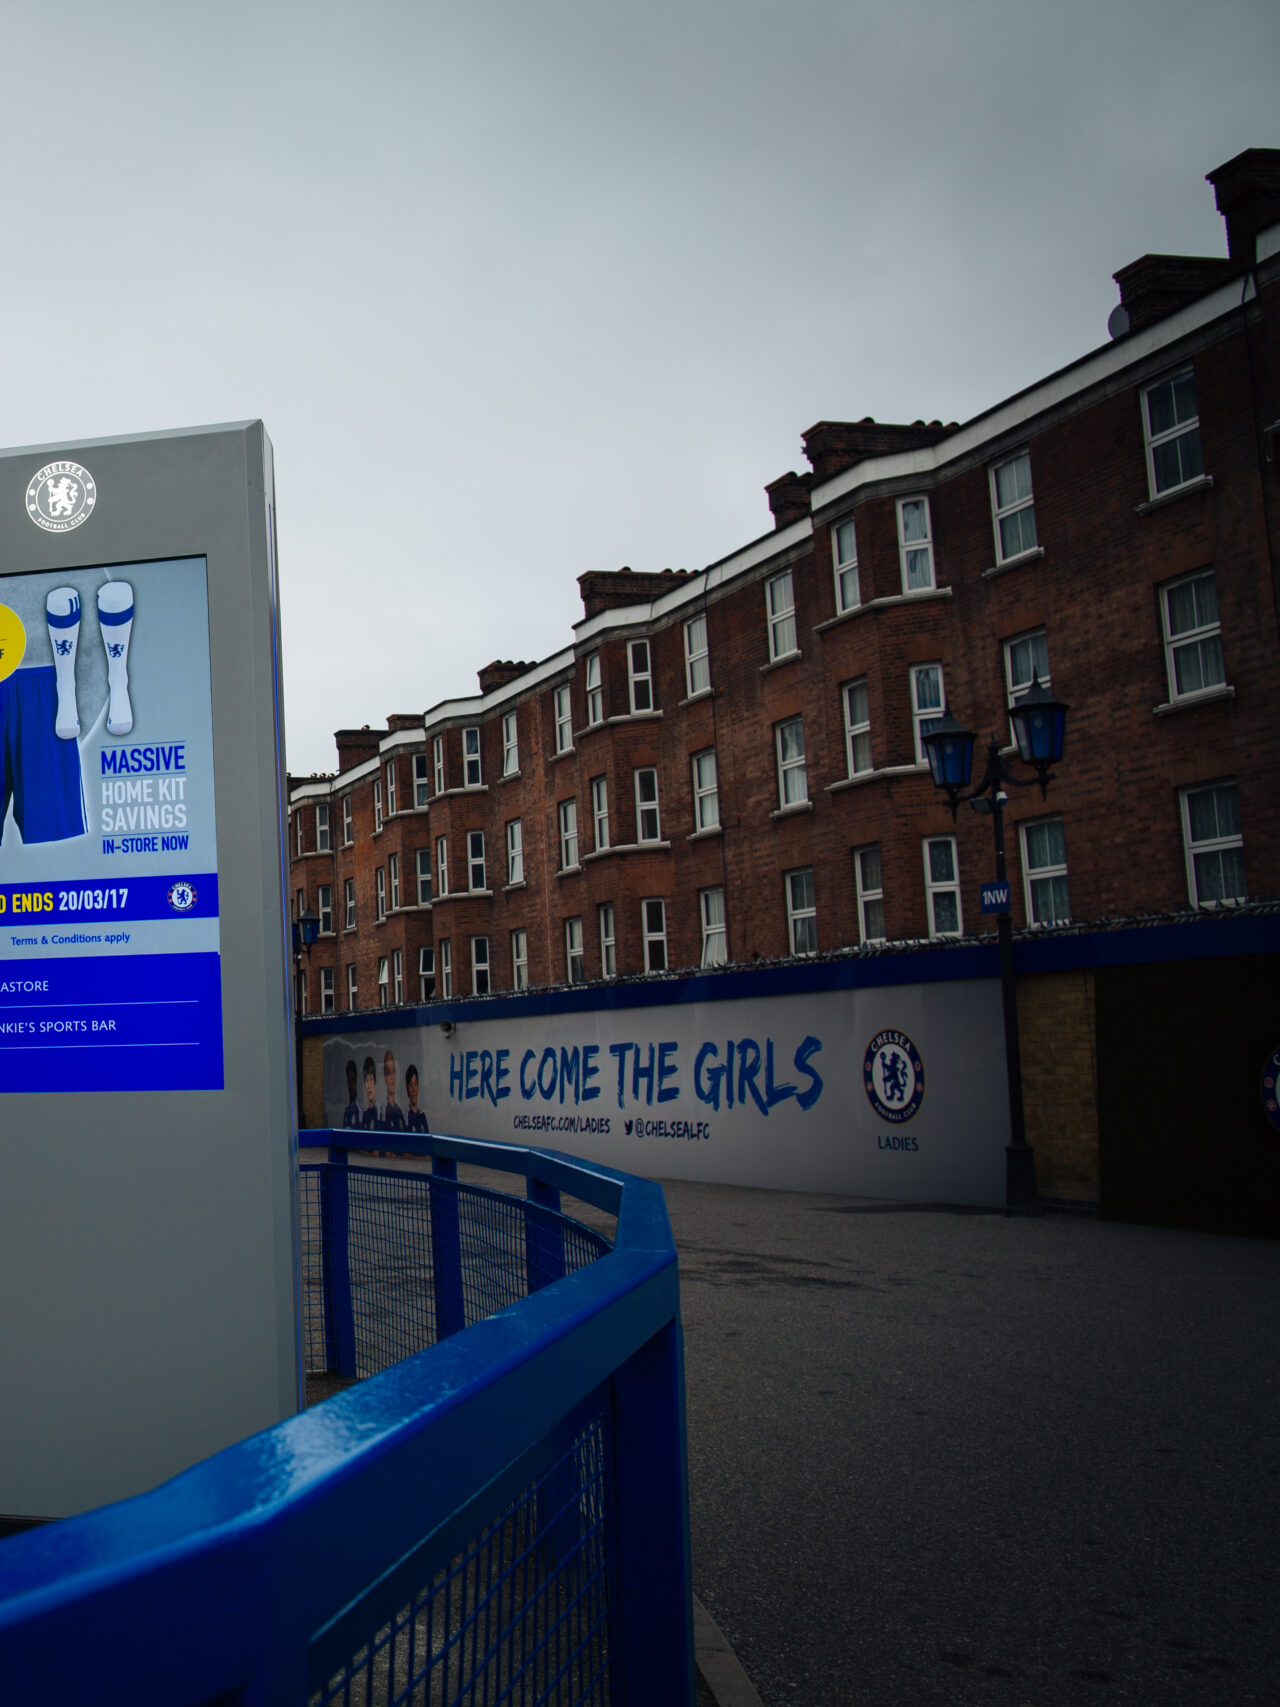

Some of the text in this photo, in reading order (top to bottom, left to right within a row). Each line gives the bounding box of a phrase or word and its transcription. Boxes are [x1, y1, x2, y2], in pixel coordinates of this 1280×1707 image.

[37, 463, 83, 481] CHELSEA
[37, 512, 86, 529] FOOTBALL CLUB
[101, 745, 186, 775] MASSIVE
[102, 777, 187, 805] HOME KIT
[101, 803, 187, 832] SAVINGS
[102, 835, 189, 855] IN-STORE NOW
[12, 892, 54, 913] ENDS
[58, 888, 129, 911] 20/03/17
[982, 888, 1008, 905] 1NW
[10, 931, 131, 946] Terms & Conditions apply
[39, 1020, 87, 1033] SPORTS
[91, 1019, 117, 1031] BAR
[871, 1032, 911, 1052] CHELSEA
[449, 1035, 823, 1117] HERE COME THE GIRLS
[875, 1102, 902, 1120] FOOTBALL
[513, 1115, 710, 1140] CHELSEAFC.COM/LADIES @CHELSEALFC
[878, 1136, 919, 1152] LADIES
